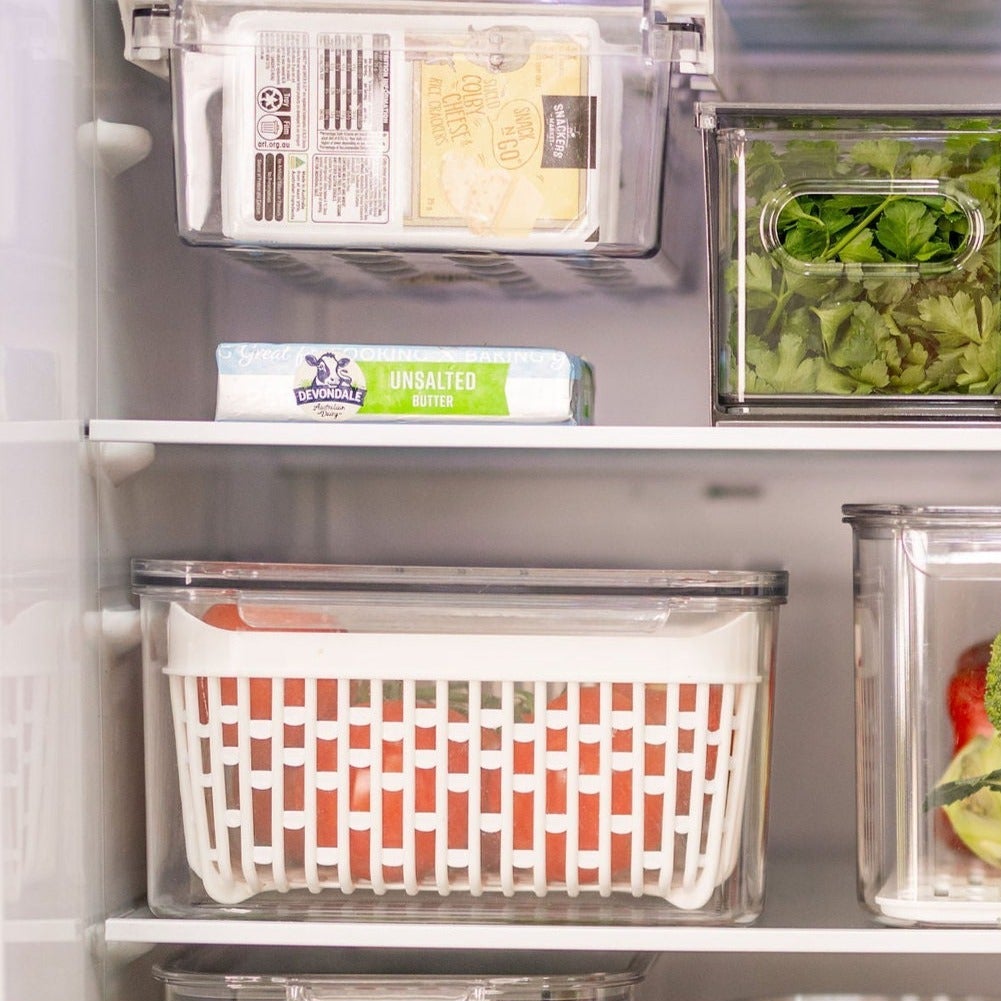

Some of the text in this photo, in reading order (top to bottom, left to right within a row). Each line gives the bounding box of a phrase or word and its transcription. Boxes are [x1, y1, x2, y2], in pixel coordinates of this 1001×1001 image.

[282, 92, 291, 107] Tray
[462, 74, 486, 116] COLBY
[283, 121, 291, 135] Film
[442, 92, 471, 143] CHEESE
[513, 107, 535, 141] SNACK
[552, 103, 567, 159] SNACKERS
[497, 139, 520, 162] GO
[389, 371, 476, 391] UNSALTED
[298, 388, 362, 402] DEVONDALE
[412, 394, 454, 408] BUTTER
